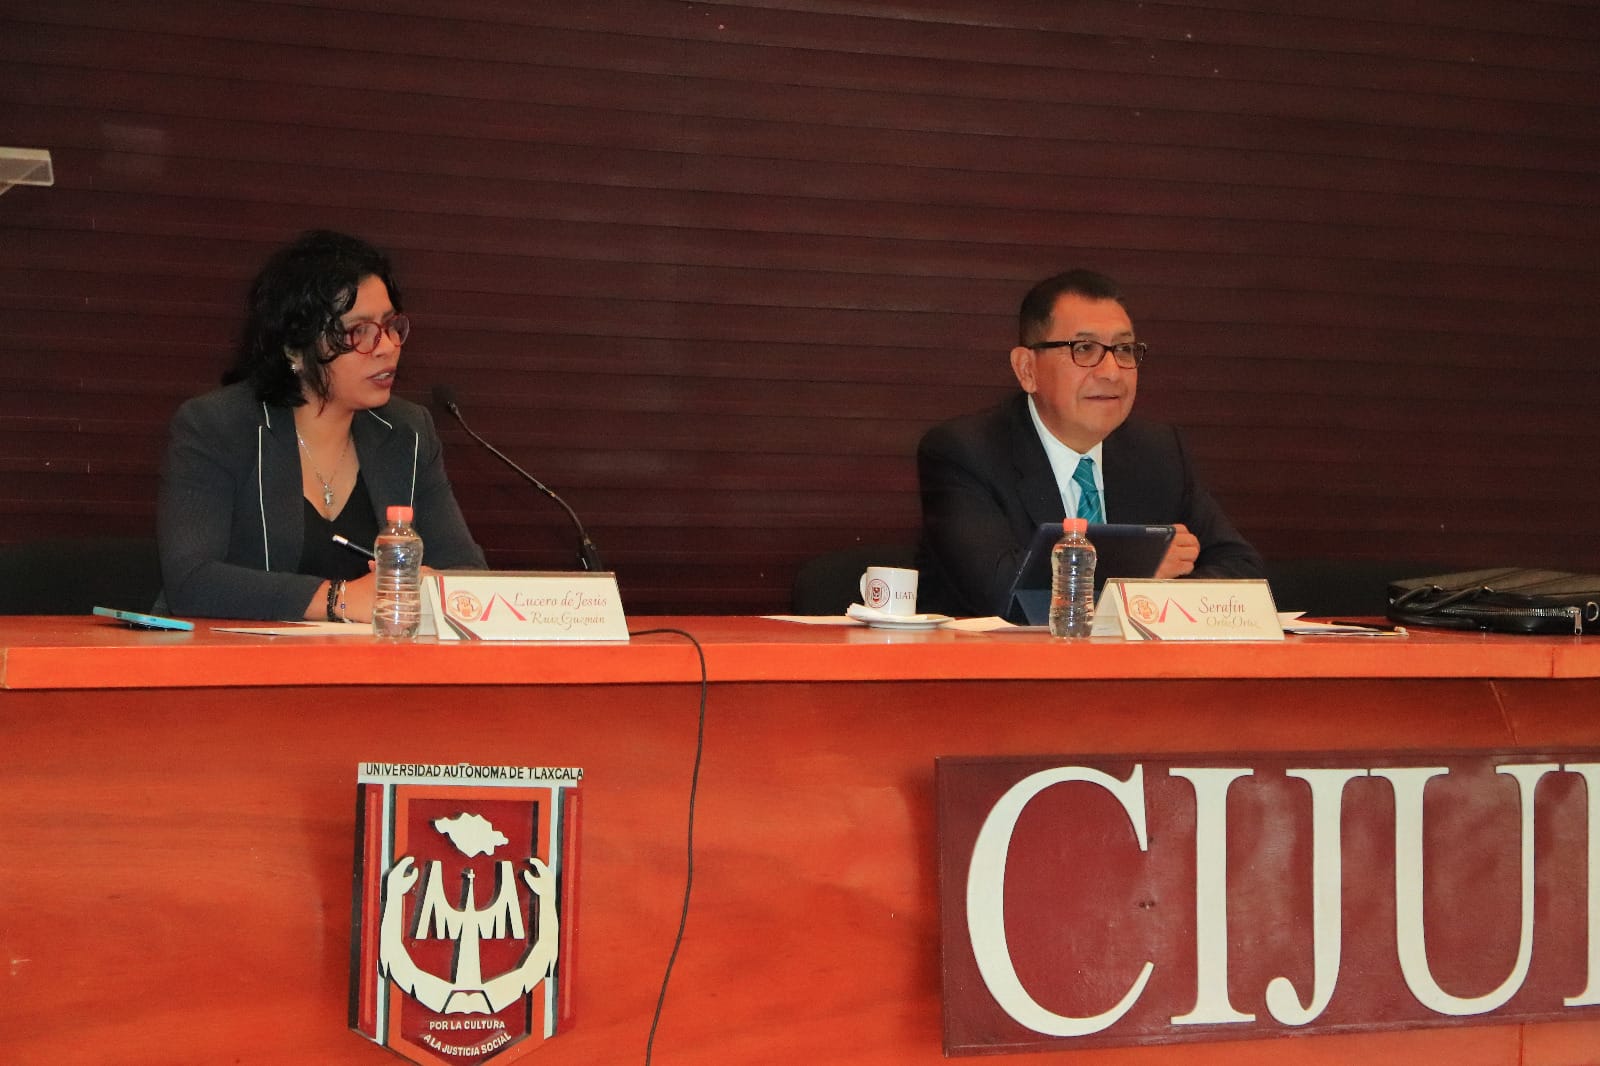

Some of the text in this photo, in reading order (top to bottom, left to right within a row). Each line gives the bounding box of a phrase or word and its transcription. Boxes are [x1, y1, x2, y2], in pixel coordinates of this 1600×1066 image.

[513, 590, 607, 610] Lucero de Jesús
[366, 763, 583, 780] UNIVERSIDAD AUTÓNOMA DE TLAXCALA
[429, 1020, 506, 1031] POR LA CULTURA
[423, 1032, 512, 1056] A LA JUSTICIA SOCIAL
